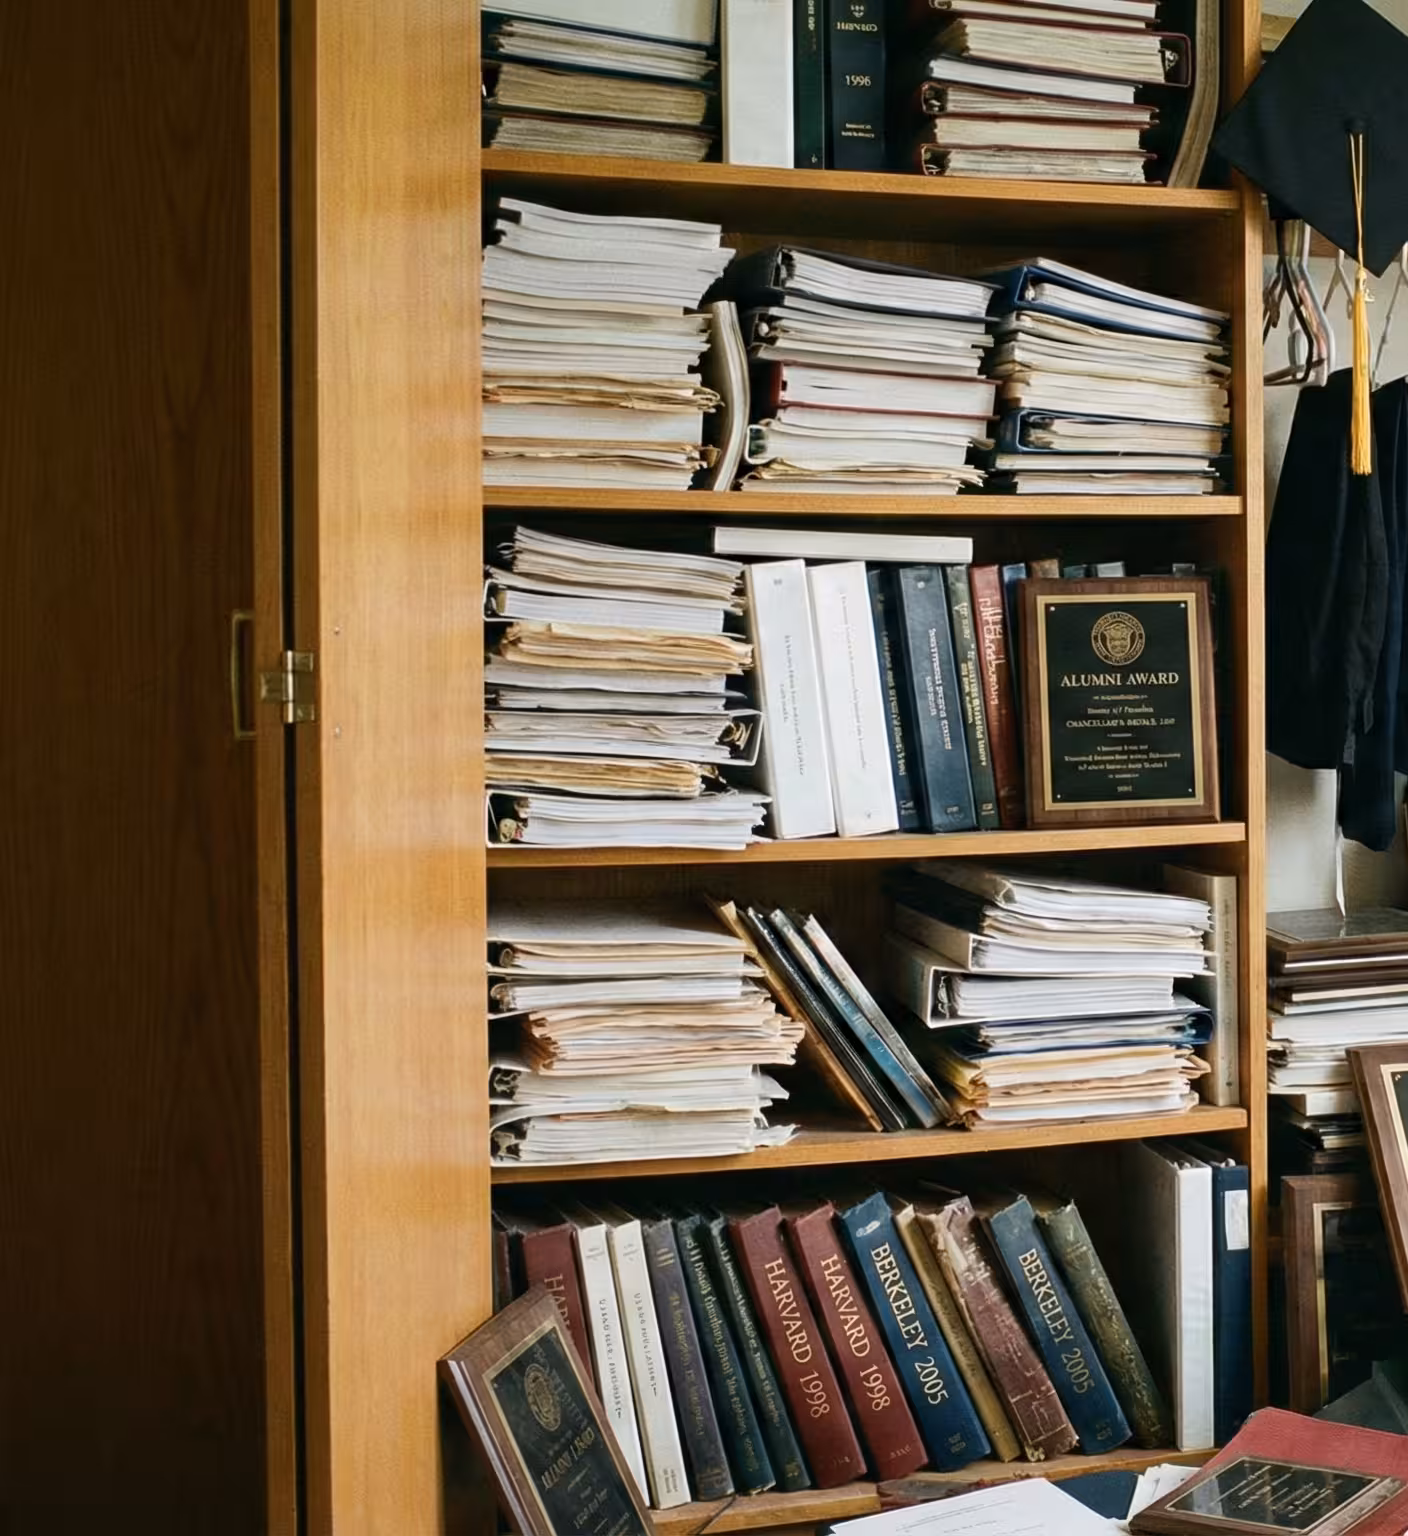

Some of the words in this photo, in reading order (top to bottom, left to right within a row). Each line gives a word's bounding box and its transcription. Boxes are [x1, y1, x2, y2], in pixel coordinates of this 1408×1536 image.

[845, 75, 871, 87] 1996
[1060, 672, 1121, 687] ALUMNI
[1126, 671, 1179, 686] AWARD
[764, 1257, 812, 1364] HARVARD
[800, 1369, 830, 1418] 1998
[820, 1254, 871, 1358] HARVARD
[859, 1364, 891, 1411] 1998
[871, 1241, 929, 1350] BERKELEY
[914, 1356, 949, 1405] 2005
[1018, 1248, 1075, 1345] BERKELEY
[1061, 1348, 1095, 1394] 2005
